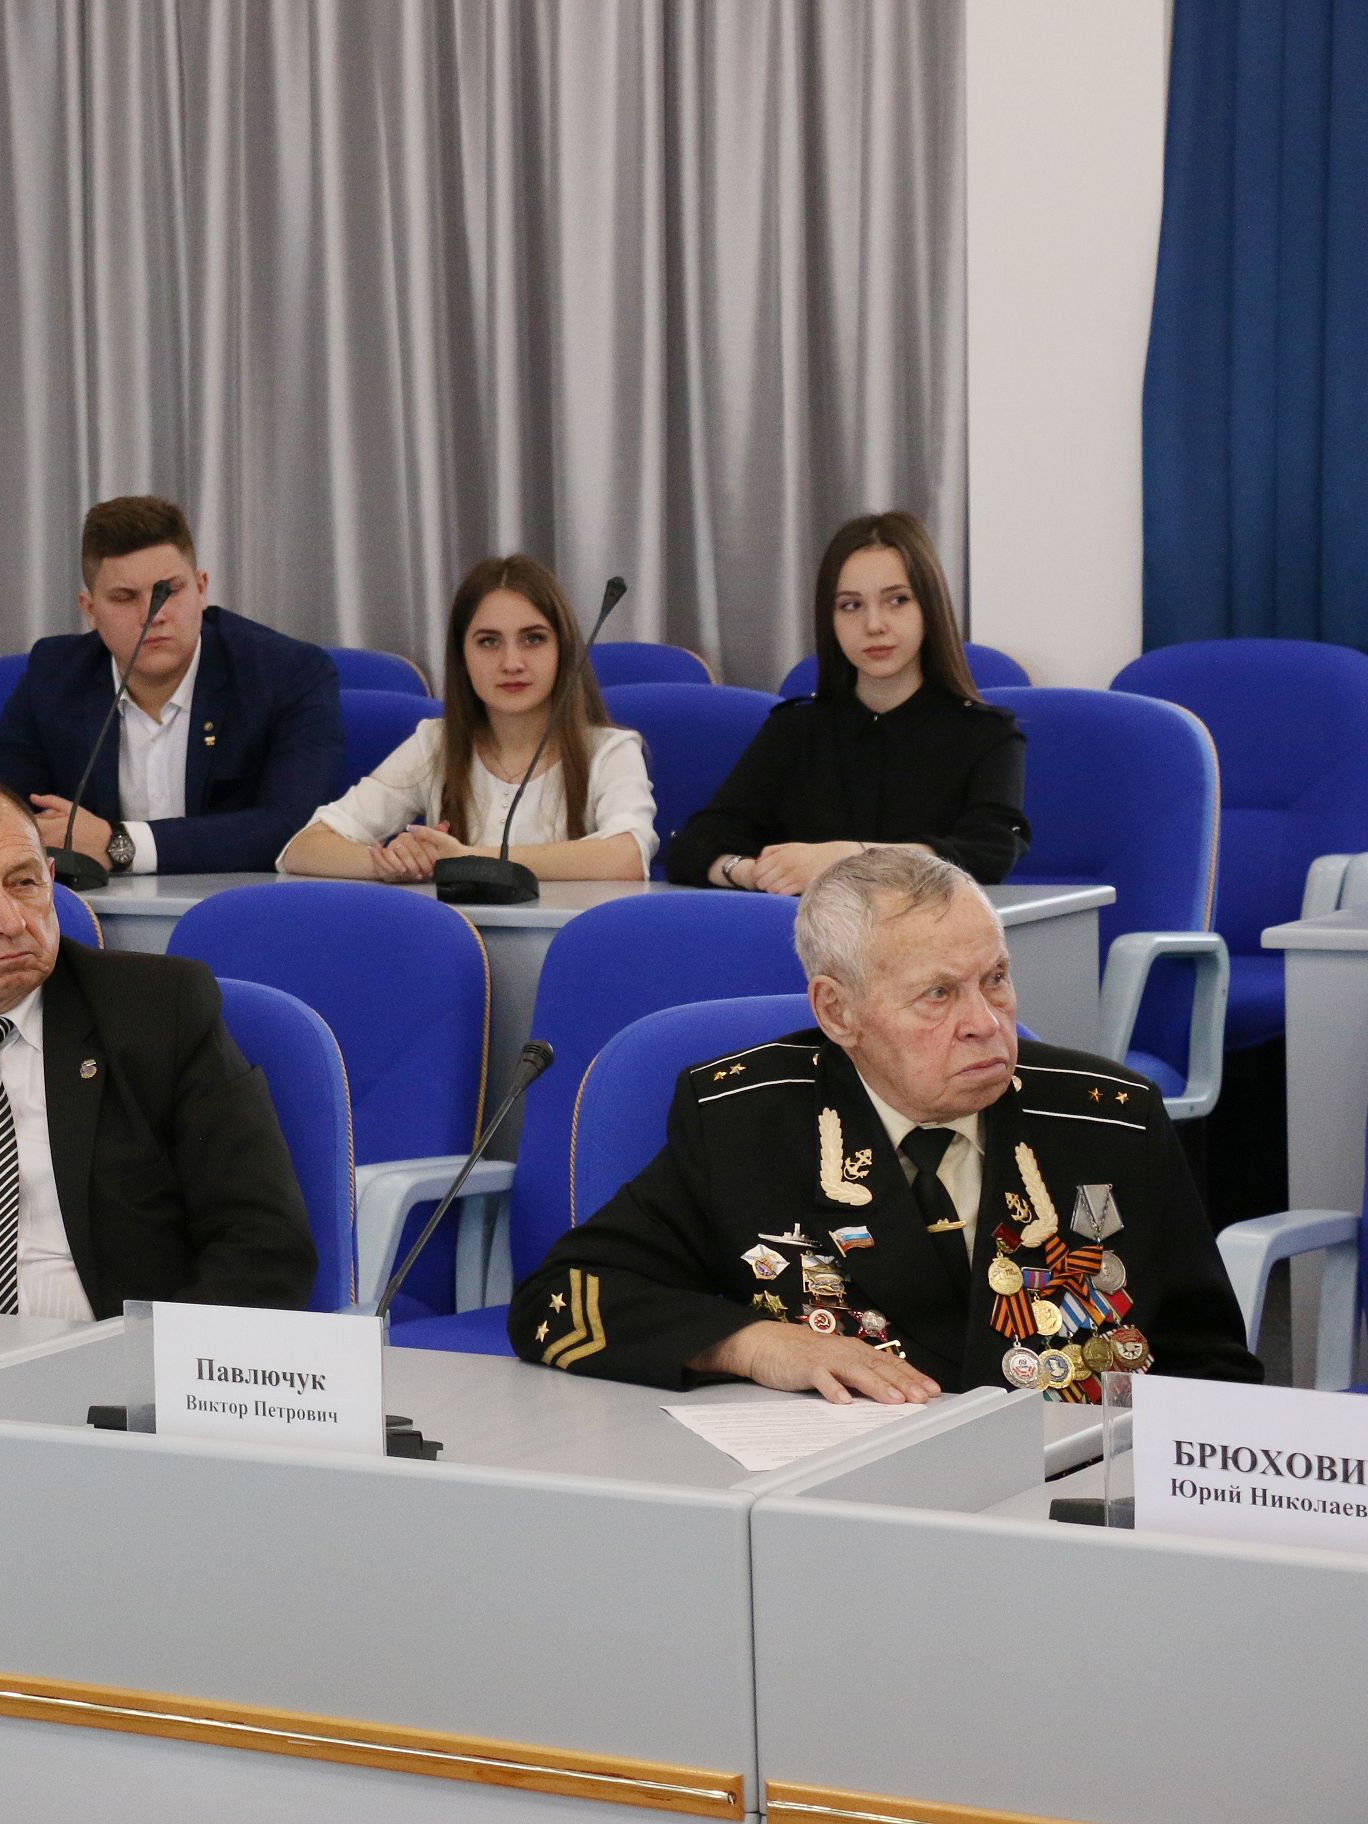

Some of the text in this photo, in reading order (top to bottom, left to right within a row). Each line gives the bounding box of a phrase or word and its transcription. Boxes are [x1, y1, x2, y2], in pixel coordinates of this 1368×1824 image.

[195, 1357, 327, 1395] Павлючук
[185, 1394, 338, 1424] Виктор Петрович
[1172, 1439, 1368, 1486] БРЮХОВИ
[1170, 1477, 1368, 1518] Юрий Николаев
